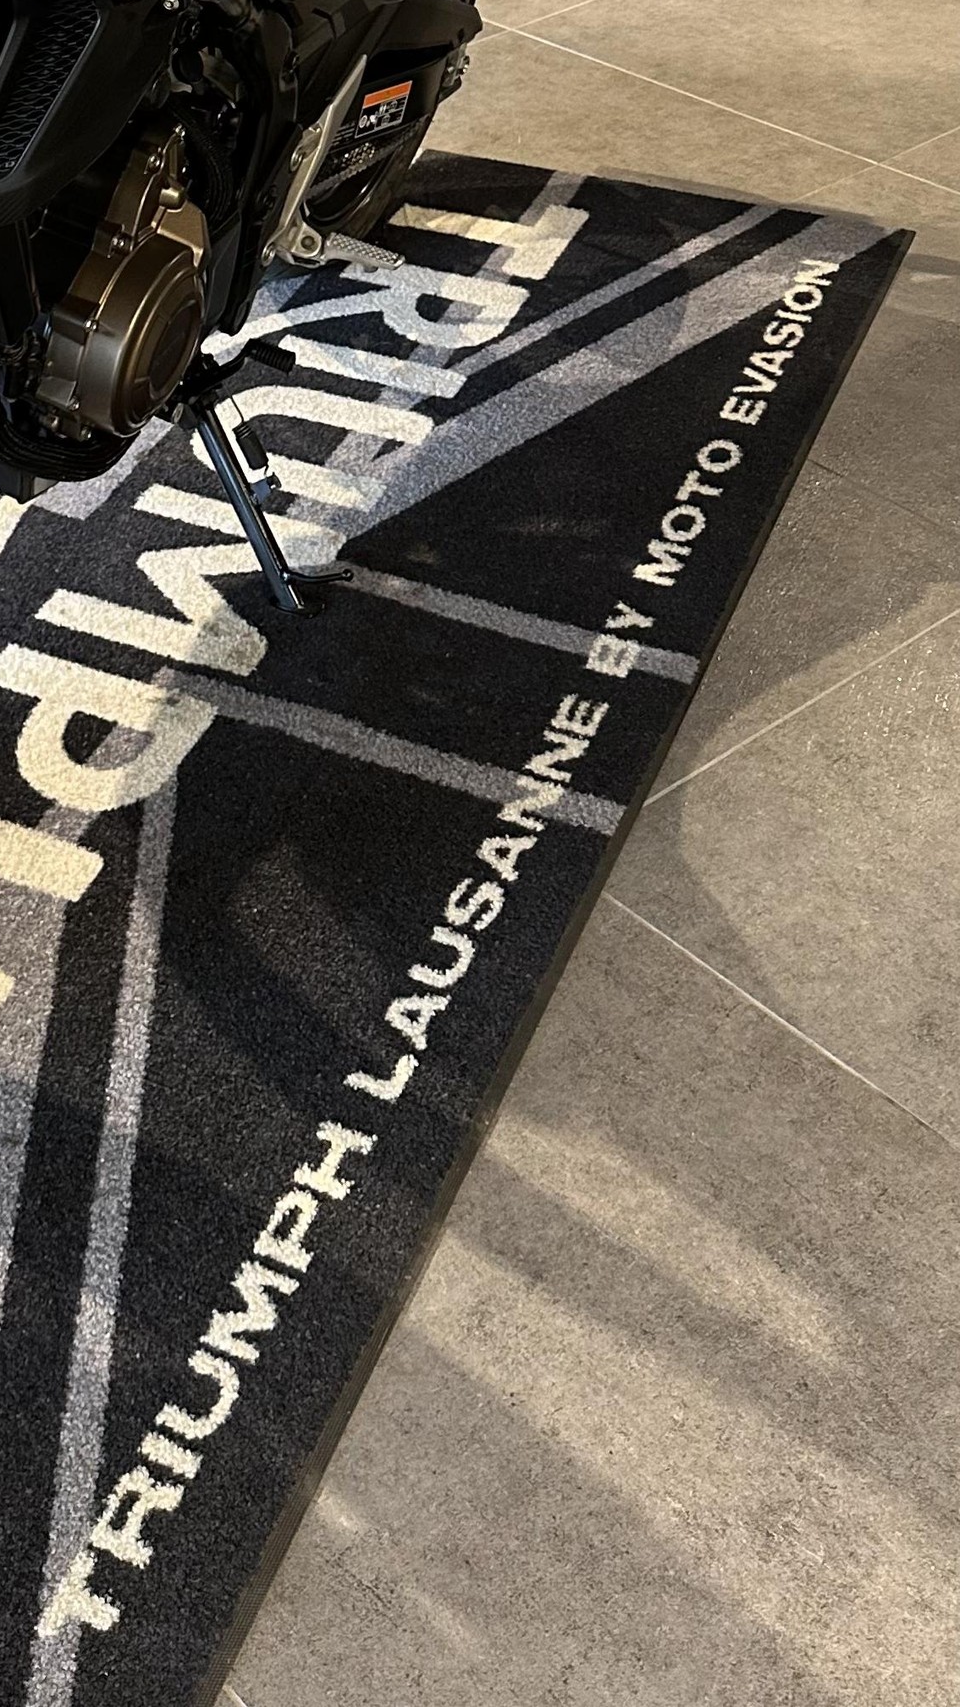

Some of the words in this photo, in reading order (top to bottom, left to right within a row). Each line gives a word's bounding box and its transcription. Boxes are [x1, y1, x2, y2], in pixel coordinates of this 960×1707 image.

[36, 1118, 377, 1639] TRIUMPH
[343, 692, 610, 1104] LAUSANNE
[585, 600, 655, 678] BY
[632, 439, 743, 587] MOTO
[719, 258, 841, 427] EVASION
